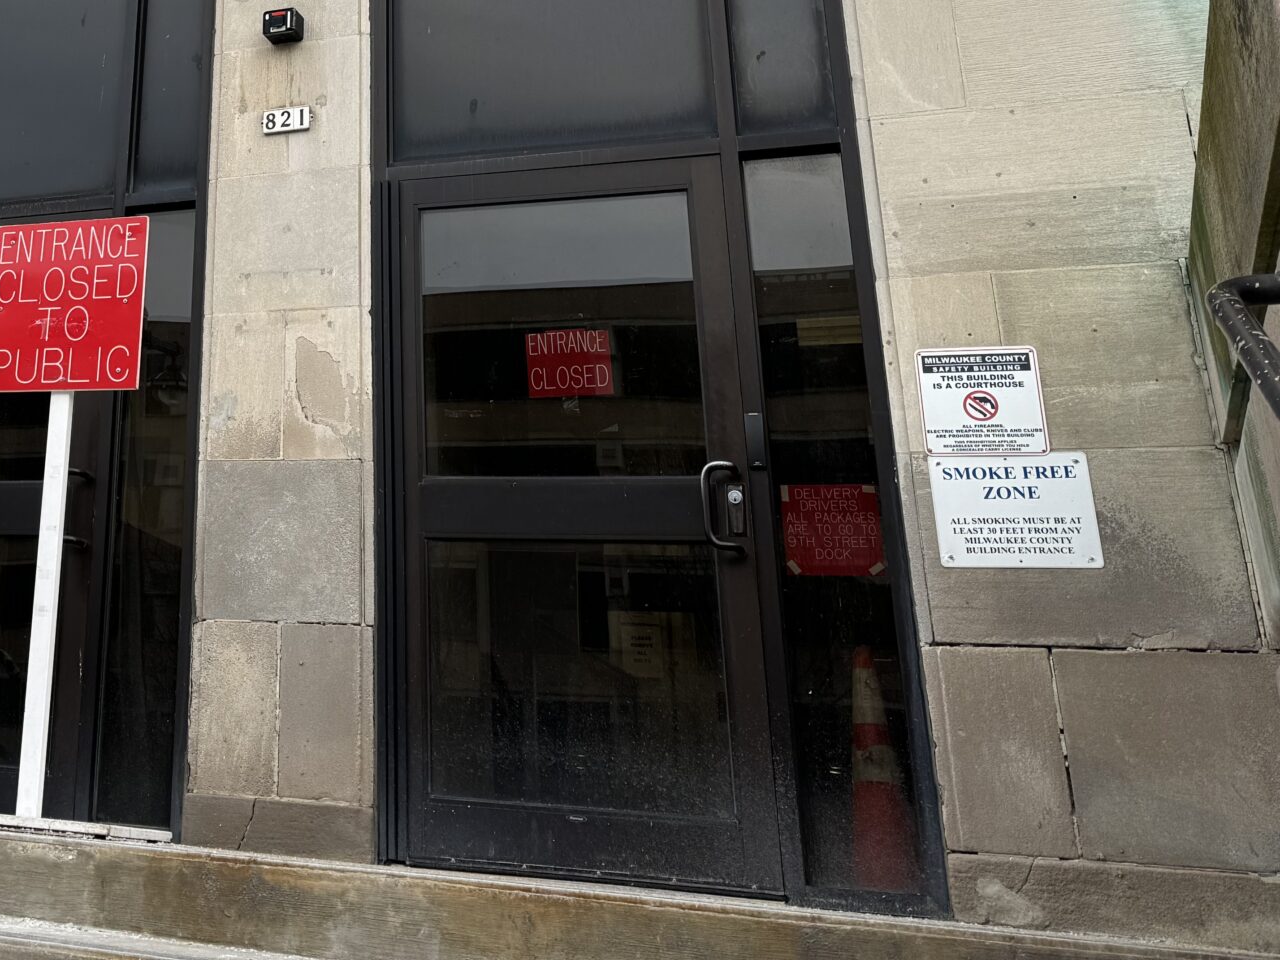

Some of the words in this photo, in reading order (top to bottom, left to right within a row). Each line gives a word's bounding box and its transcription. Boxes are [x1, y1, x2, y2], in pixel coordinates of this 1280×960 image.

[265, 108, 304, 130] 821
[0, 223, 140, 265] ENTRANCE
[38, 305, 89, 341] TO
[528, 330, 607, 356] ENTRANCE
[924, 355, 982, 364] MILWAUKEE
[985, 354, 1026, 363] COUNTY
[932, 365, 968, 373] SAFETY
[973, 364, 1021, 372] BUILDING
[530, 364, 609, 390] CLOSED
[966, 373, 1015, 381] BUILDING
[955, 381, 1024, 389] COURTHOUSE
[942, 466, 1017, 480] SMOKE
[1022, 465, 1077, 480] FREE
[794, 488, 860, 500] DELIVERY
[983, 486, 1041, 500] ZONE
[800, 500, 858, 511] DRIVERS
[786, 512, 808, 523] ALL
[815, 512, 875, 523] PACKAGES
[971, 517, 1020, 525] SMOKING
[787, 524, 809, 535] ARE
[816, 524, 832, 535] TO
[838, 524, 853, 535] GO
[860, 524, 877, 535] TO
[953, 527, 984, 535] LEAST
[986, 527, 997, 535] 30
[787, 536, 816, 548] 9TH
[824, 536, 878, 548] STREET
[815, 548, 852, 560] DOCK
